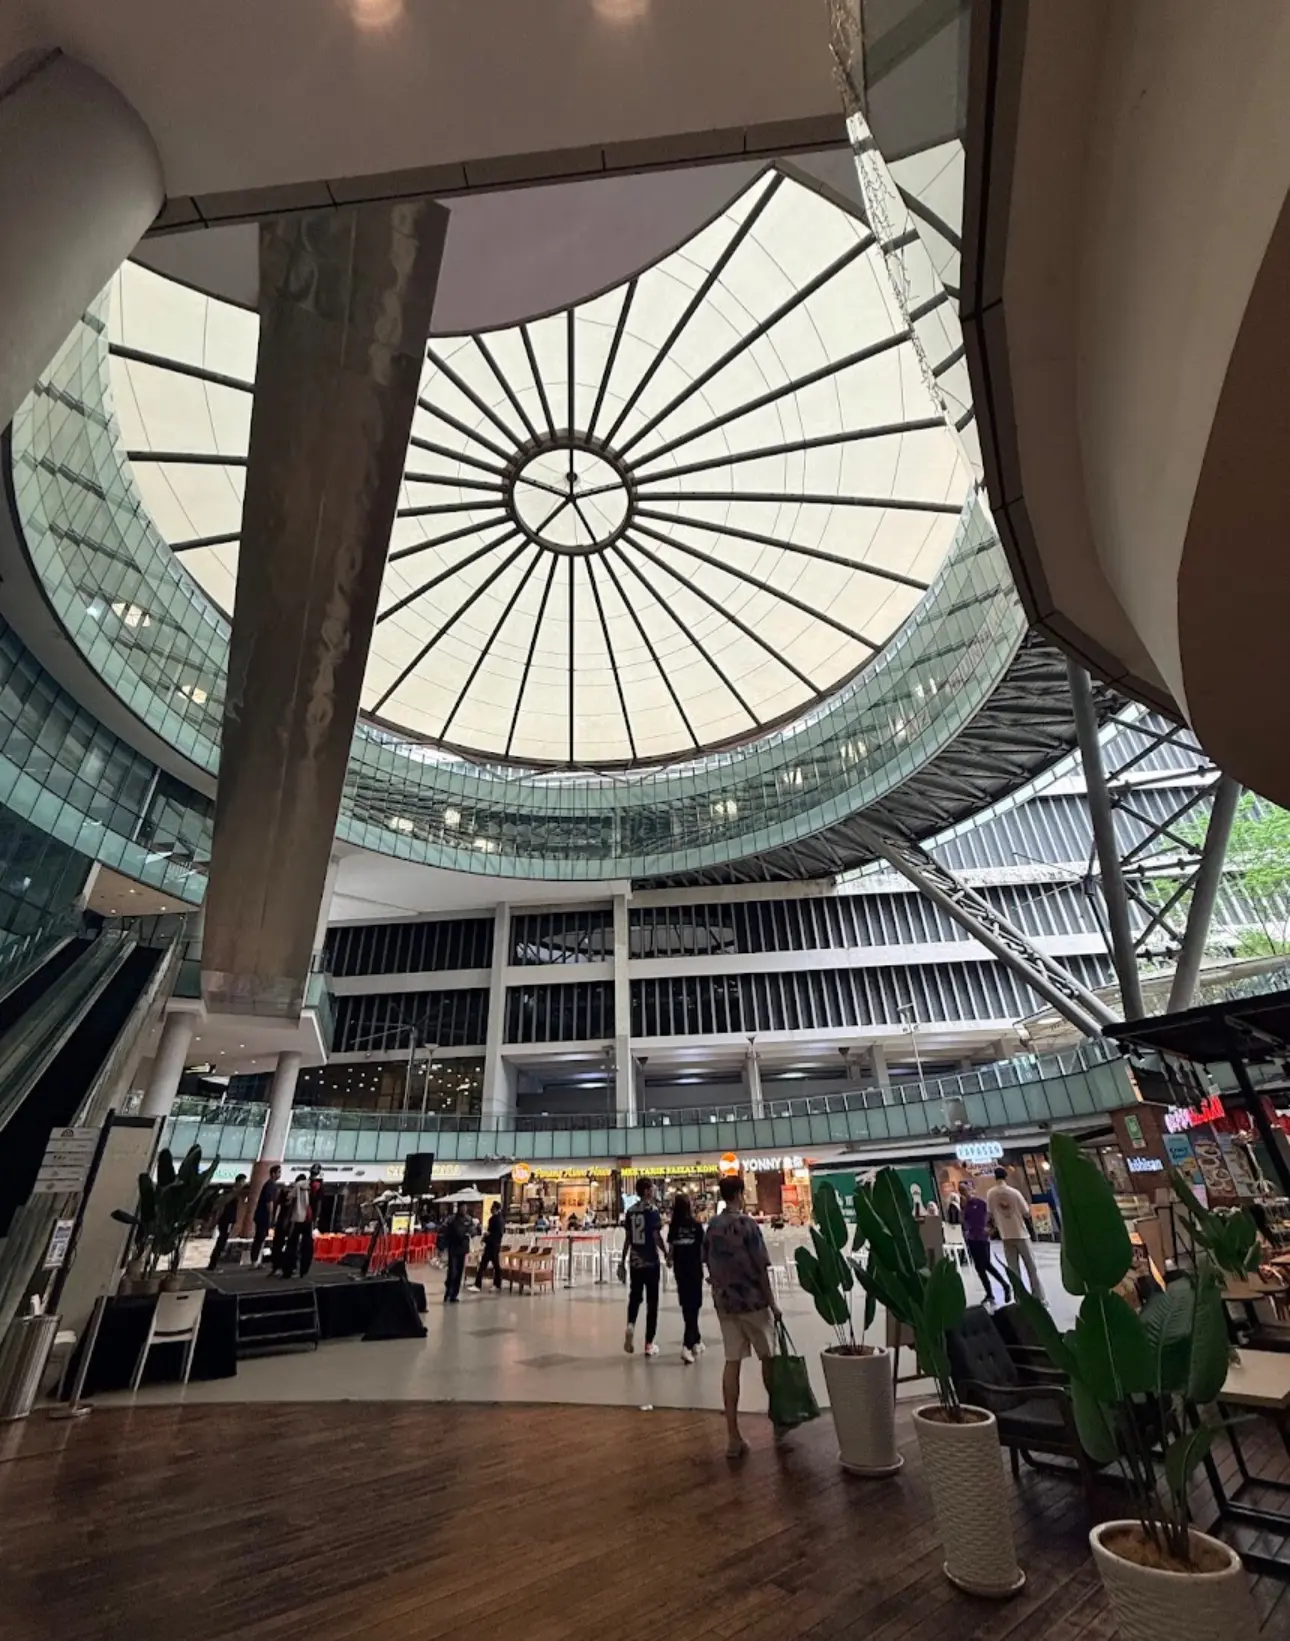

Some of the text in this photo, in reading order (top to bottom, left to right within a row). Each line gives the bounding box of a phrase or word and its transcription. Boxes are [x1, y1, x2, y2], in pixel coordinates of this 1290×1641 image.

[640, 1166, 665, 1175] TARIK
[742, 1156, 781, 1172] YONNY
[631, 1213, 646, 1245] 12
